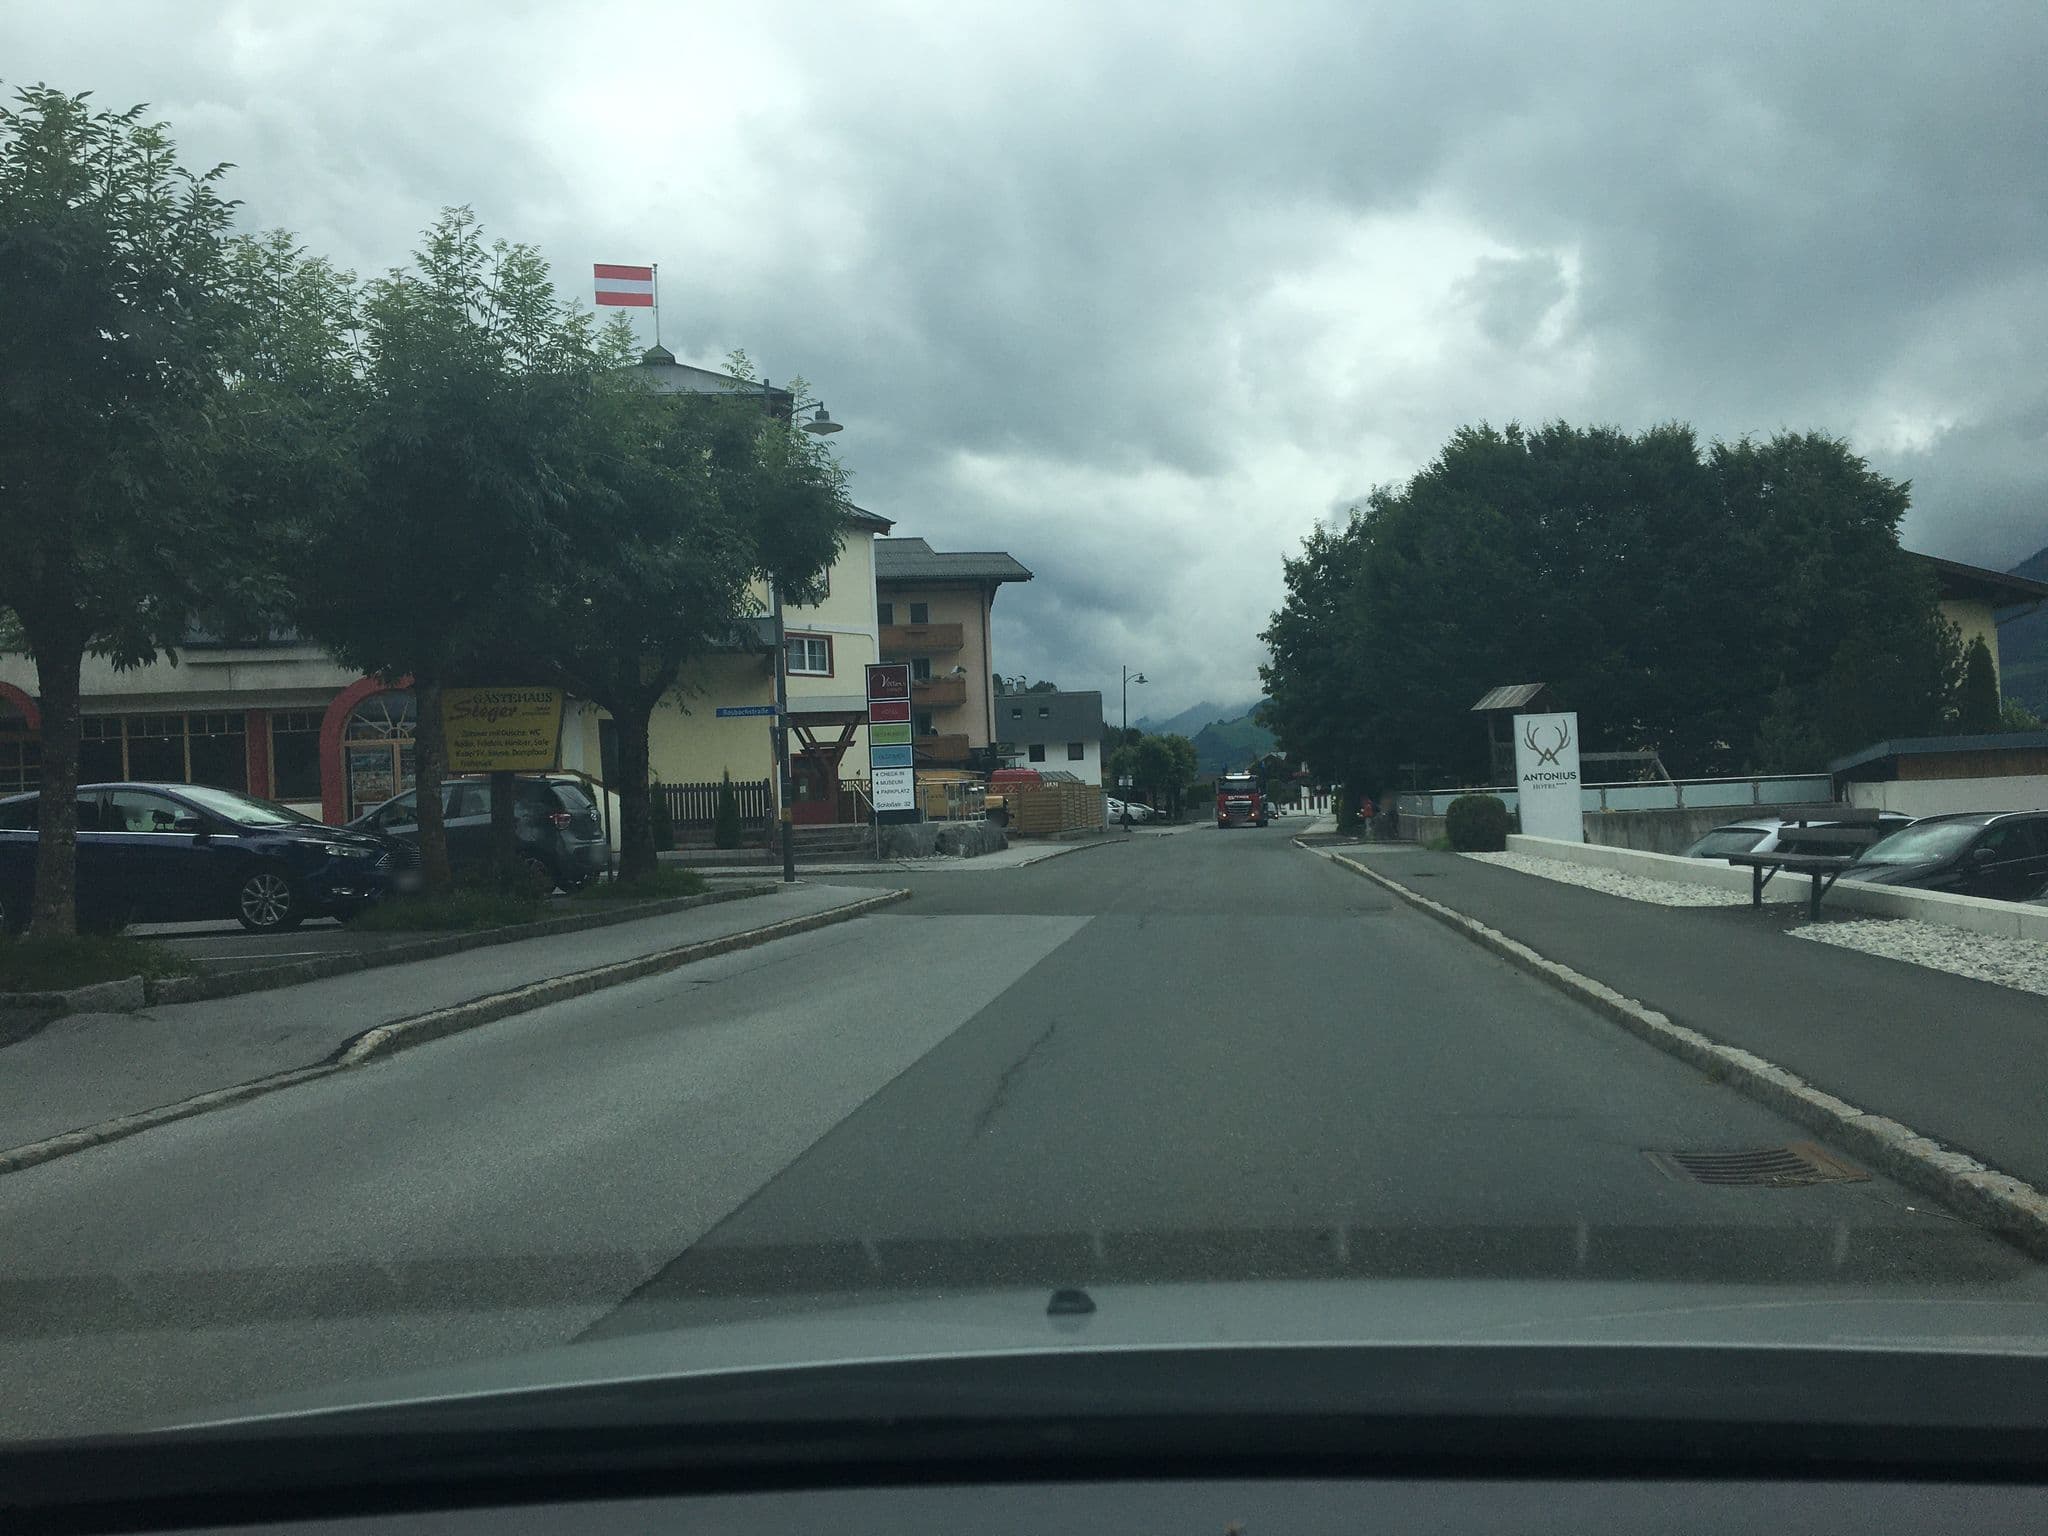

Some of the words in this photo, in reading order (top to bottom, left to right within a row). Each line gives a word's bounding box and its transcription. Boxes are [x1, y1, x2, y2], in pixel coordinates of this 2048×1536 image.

[473, 691, 552, 703] GÄSTEHAUS
[529, 728, 541, 737] WC
[534, 737, 549, 746] Safe
[1523, 771, 1577, 782] ANTONIUS
[880, 778, 903, 786] MUSEUM
[881, 787, 910, 795] PARKPLATZ
